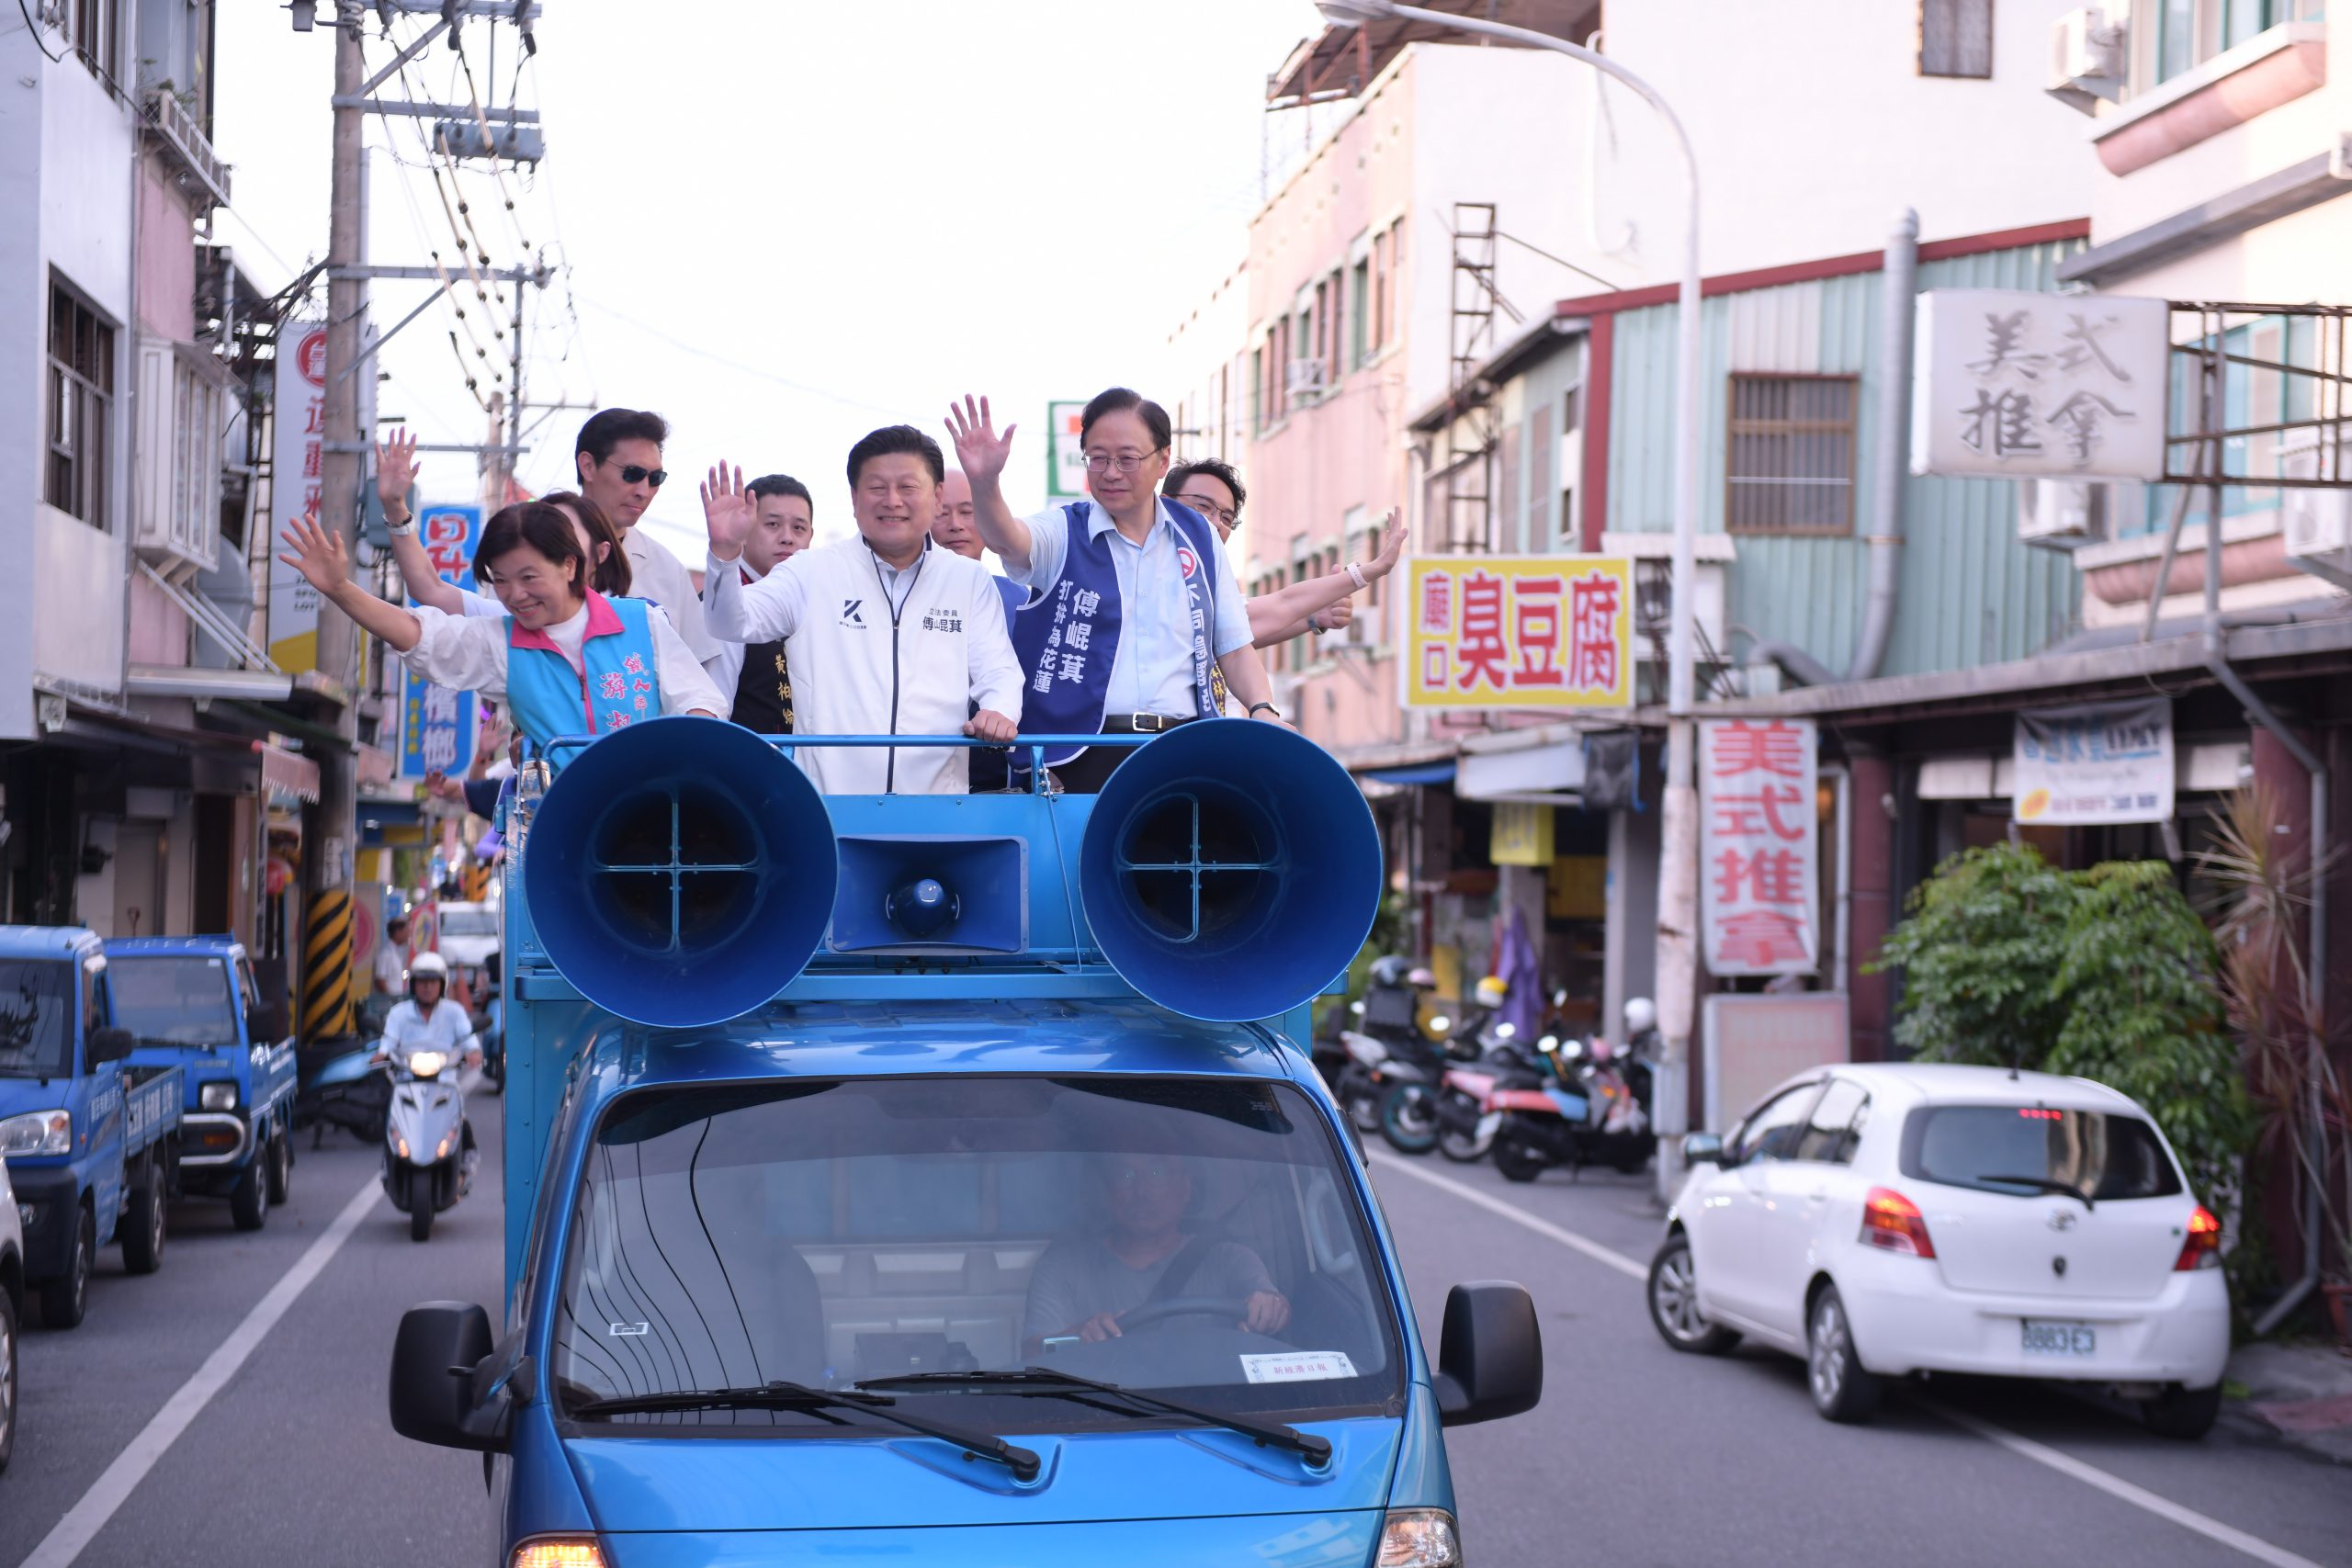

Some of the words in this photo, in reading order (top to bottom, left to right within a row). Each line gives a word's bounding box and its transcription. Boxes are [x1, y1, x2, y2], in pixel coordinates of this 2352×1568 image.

[1963, 310, 2132, 383] 美式
[1958, 387, 2137, 463] 推拿
[928, 607, 958, 617] 立法委員
[1457, 572, 1619, 690] 臭豆腐
[1712, 719, 1810, 967] 美式推拿
